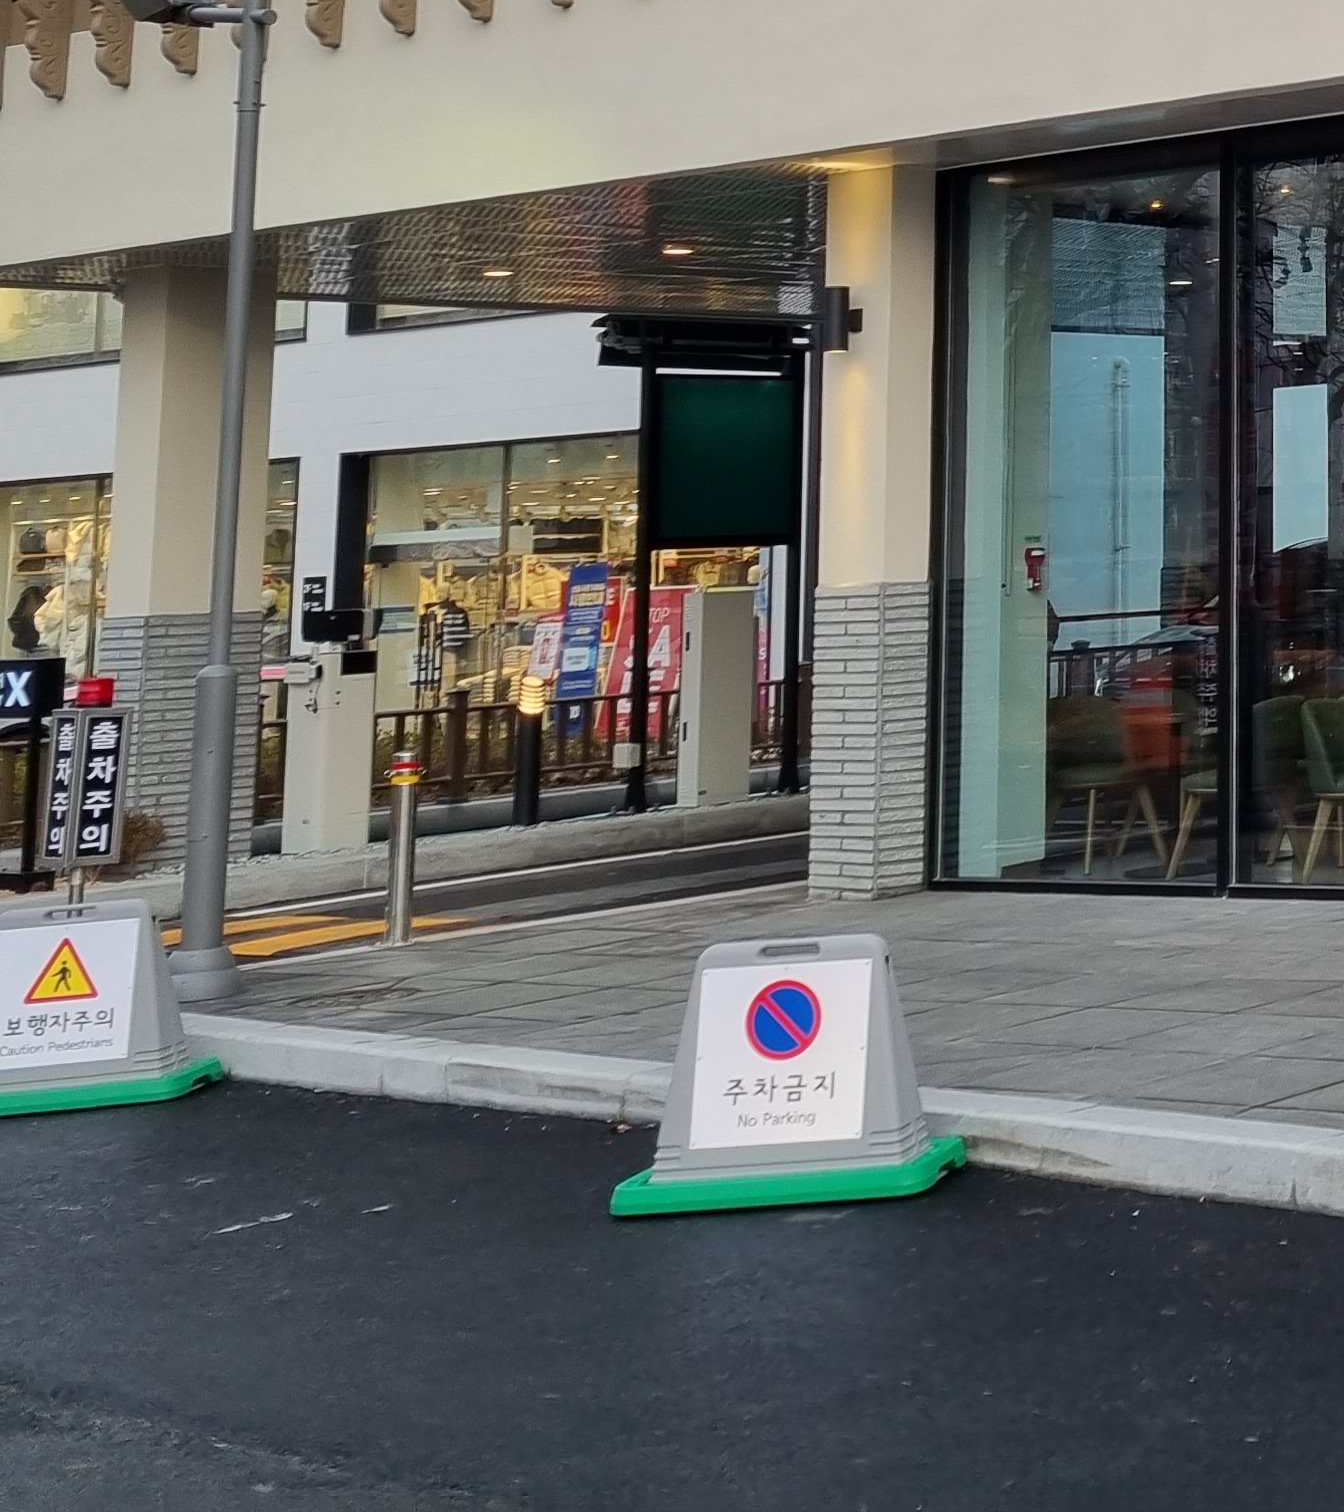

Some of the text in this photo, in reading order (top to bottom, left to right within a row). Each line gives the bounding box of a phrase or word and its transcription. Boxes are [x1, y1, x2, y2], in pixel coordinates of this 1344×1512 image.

[0, 671, 33, 708] X
[48, 722, 76, 855] 출차주의
[79, 721, 120, 853] 출차주의
[2, 1008, 115, 1037] 보행자주의
[0, 1038, 114, 1057] Caution Pedestrians
[722, 1071, 836, 1106] 주차금지
[737, 1111, 816, 1128] No Parking
